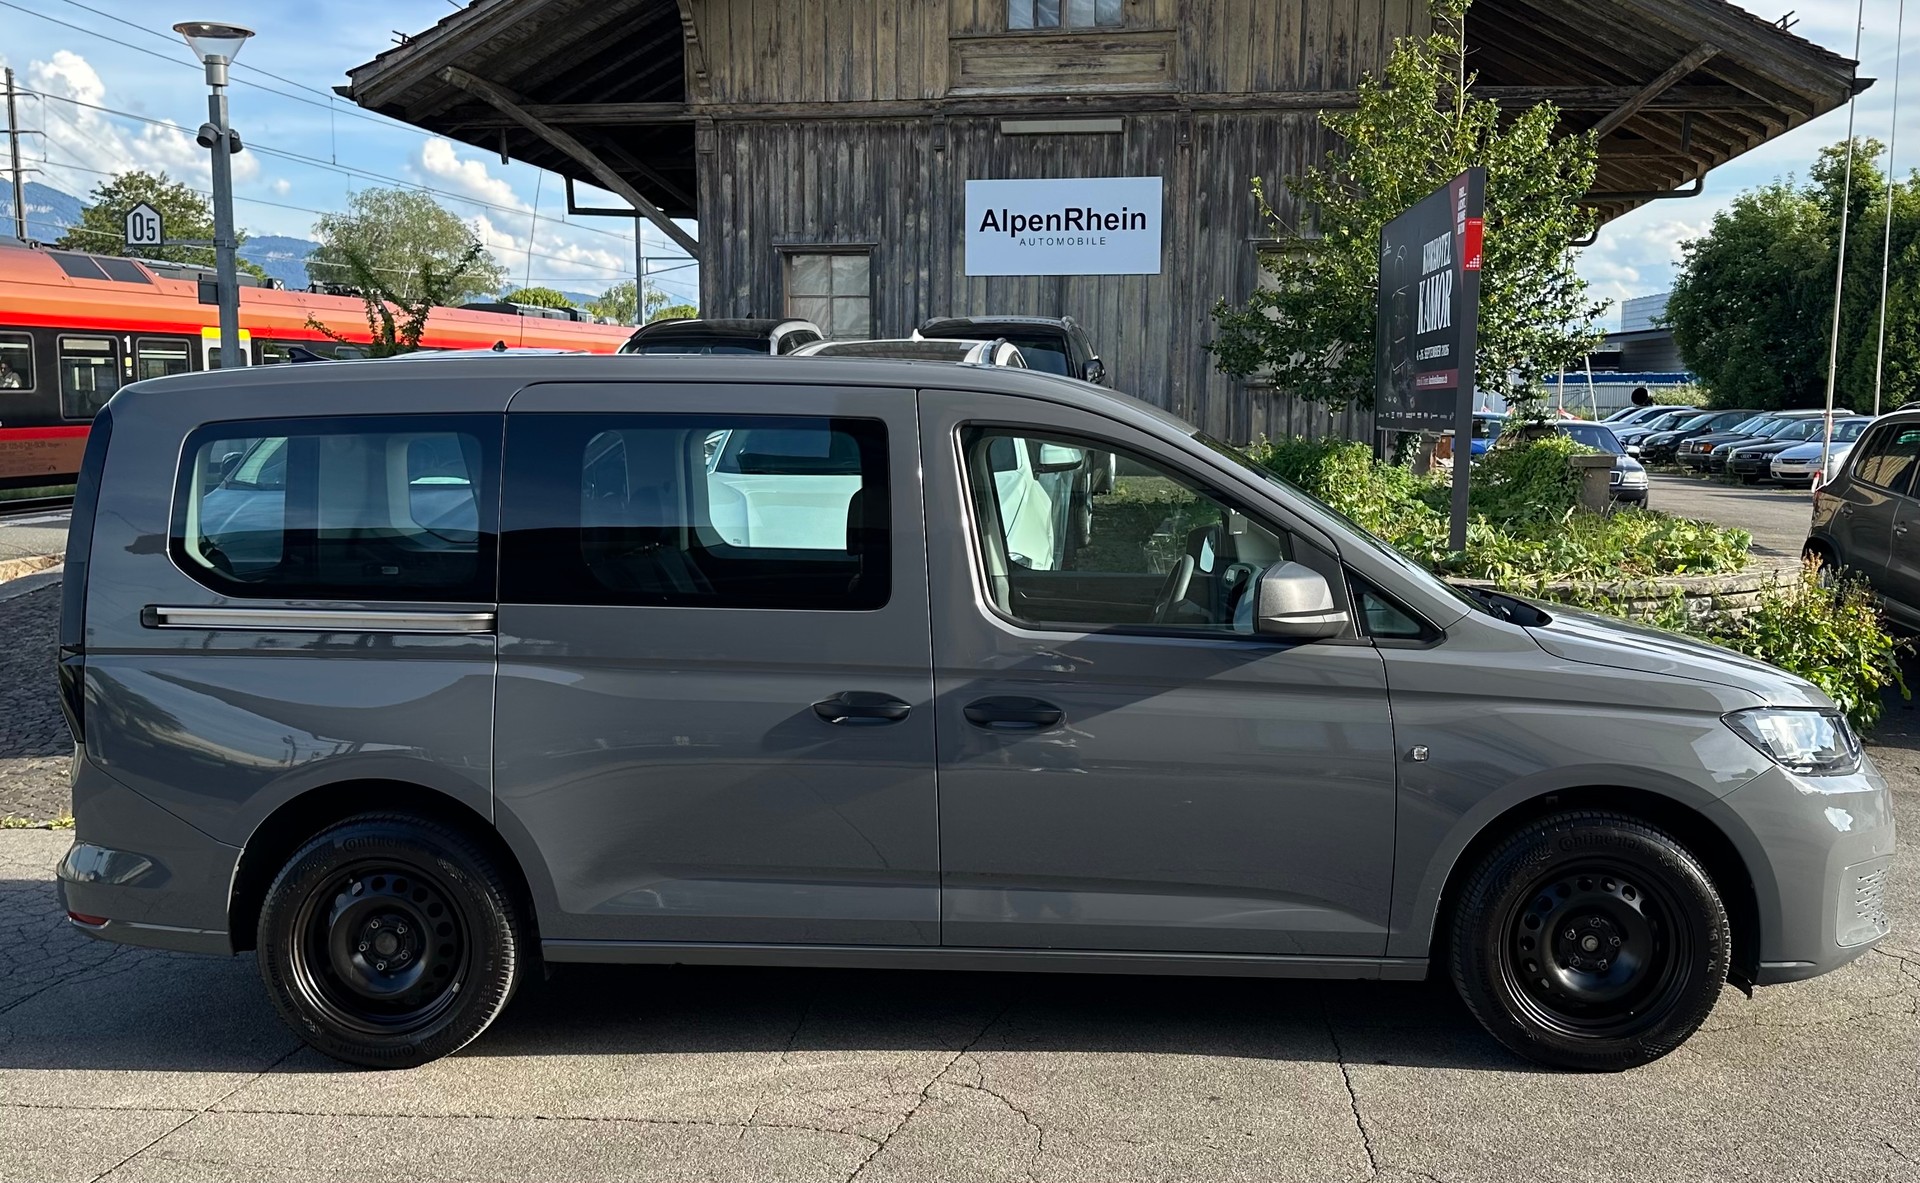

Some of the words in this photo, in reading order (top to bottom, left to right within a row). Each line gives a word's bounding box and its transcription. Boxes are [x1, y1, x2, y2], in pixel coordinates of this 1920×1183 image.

[132, 212, 156, 242] 05
[979, 207, 1146, 238] AlpenRhein
[1019, 237, 1106, 246] AUTOMOBILE
[1417, 269, 1453, 335] KAMOR
[123, 335, 131, 354] 1
[1706, 959, 1718, 972] XL
